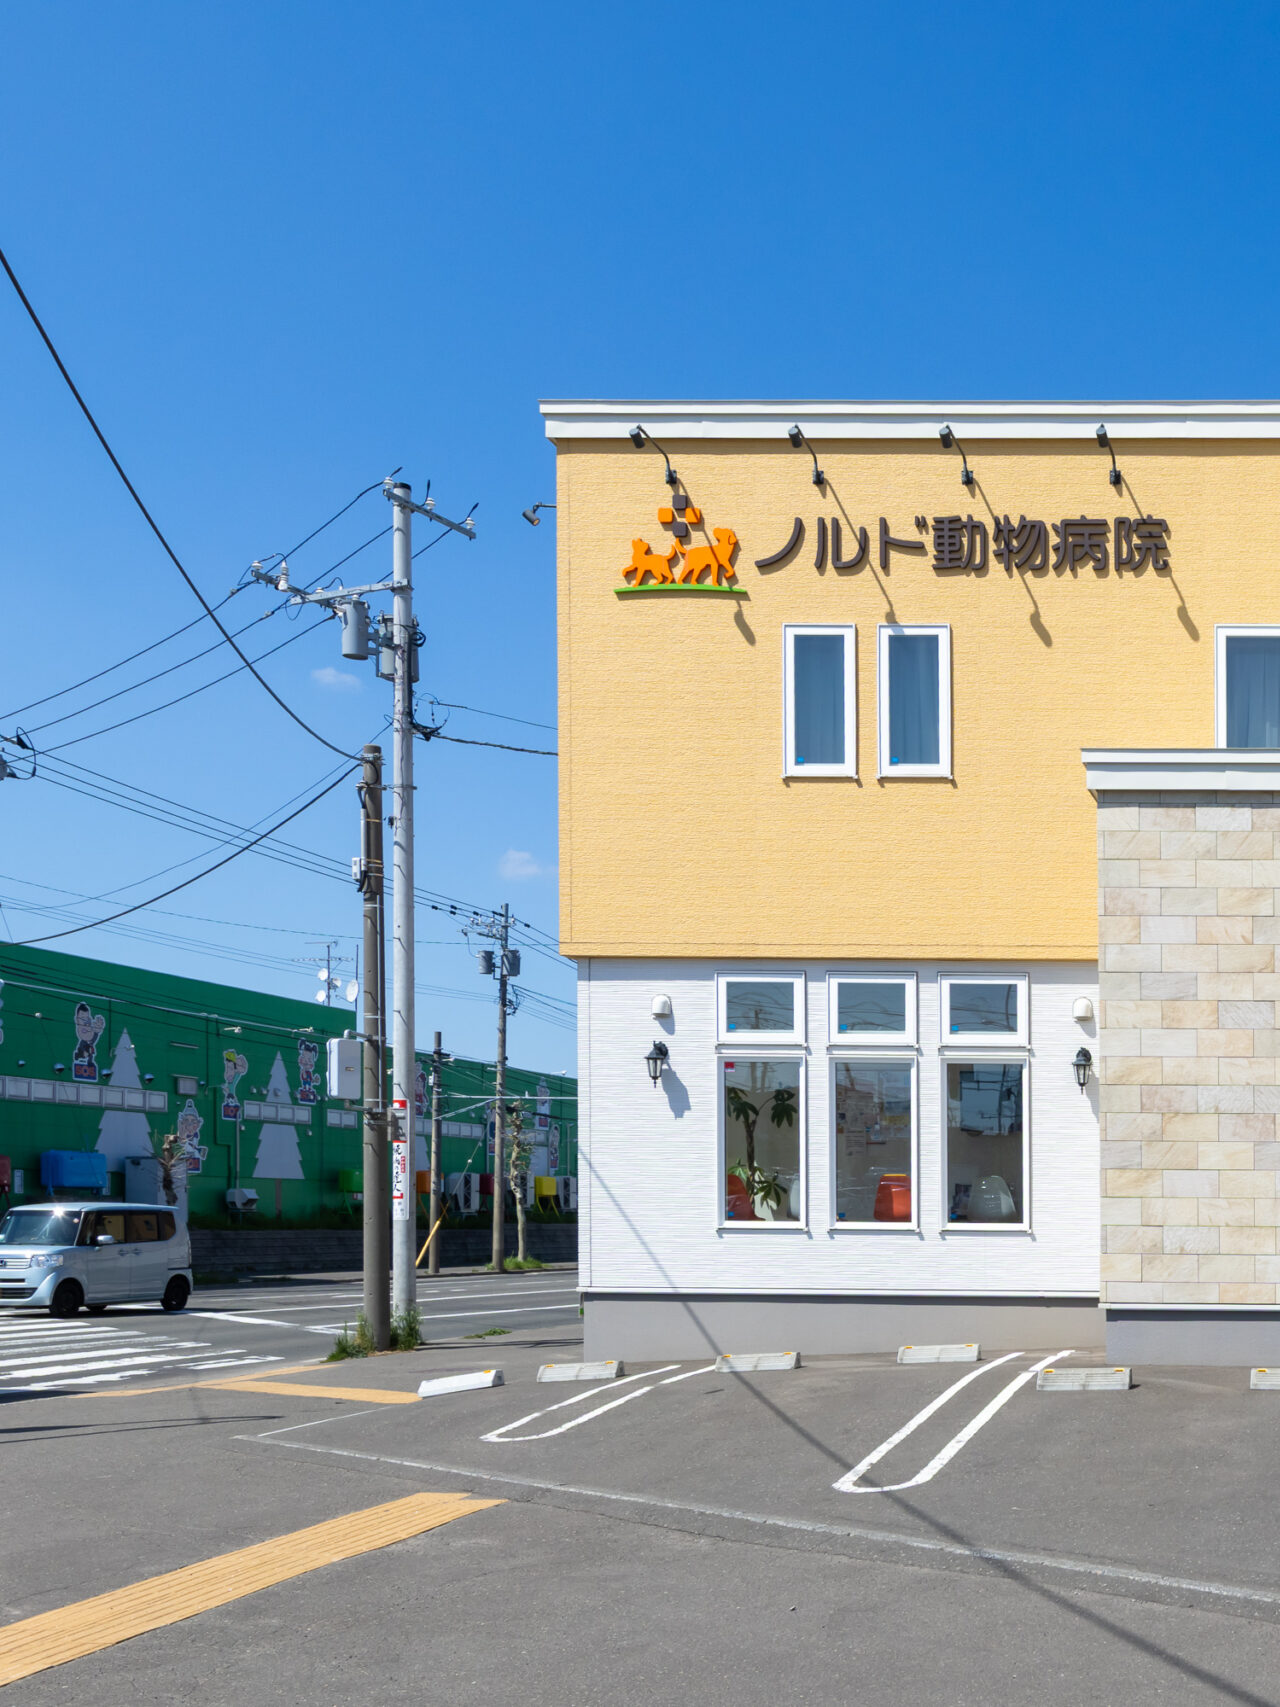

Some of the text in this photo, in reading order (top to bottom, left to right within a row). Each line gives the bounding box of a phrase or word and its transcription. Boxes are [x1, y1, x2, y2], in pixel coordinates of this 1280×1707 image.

[755, 514, 1169, 570] ノルド動物病院
